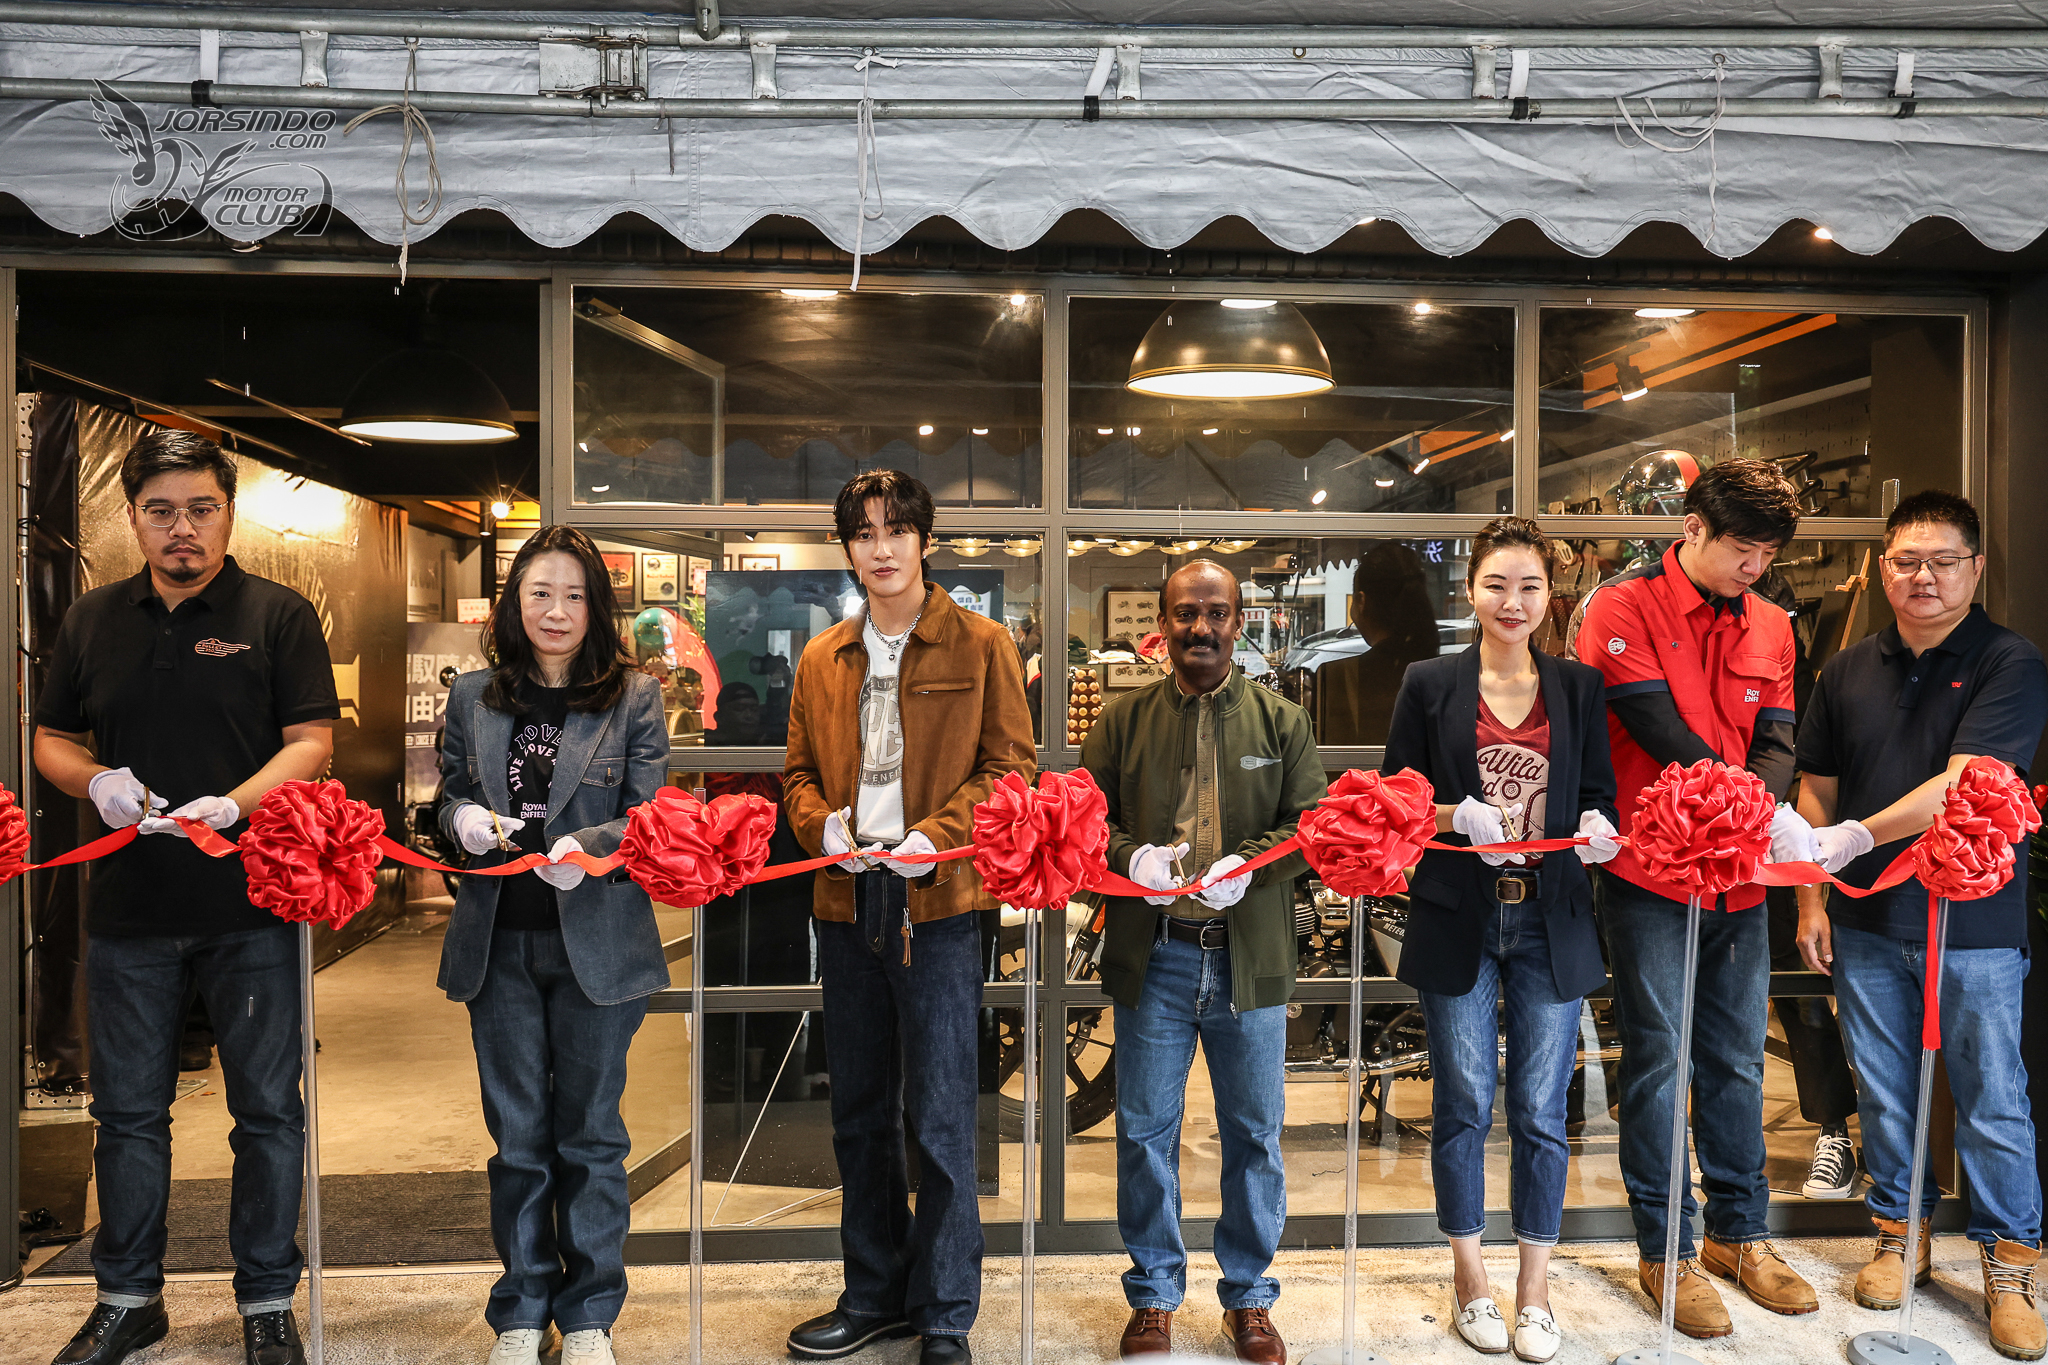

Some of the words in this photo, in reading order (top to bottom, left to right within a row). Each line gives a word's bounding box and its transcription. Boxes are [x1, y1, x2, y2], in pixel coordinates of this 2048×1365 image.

[877, 680, 896, 689] LIK
[1746, 688, 1760, 697] ROY
[1478, 748, 1545, 781] Wild
[872, 768, 900, 782] ENFI
[522, 802, 547, 812] ROYAL
[1383, 922, 1406, 937] METEO
